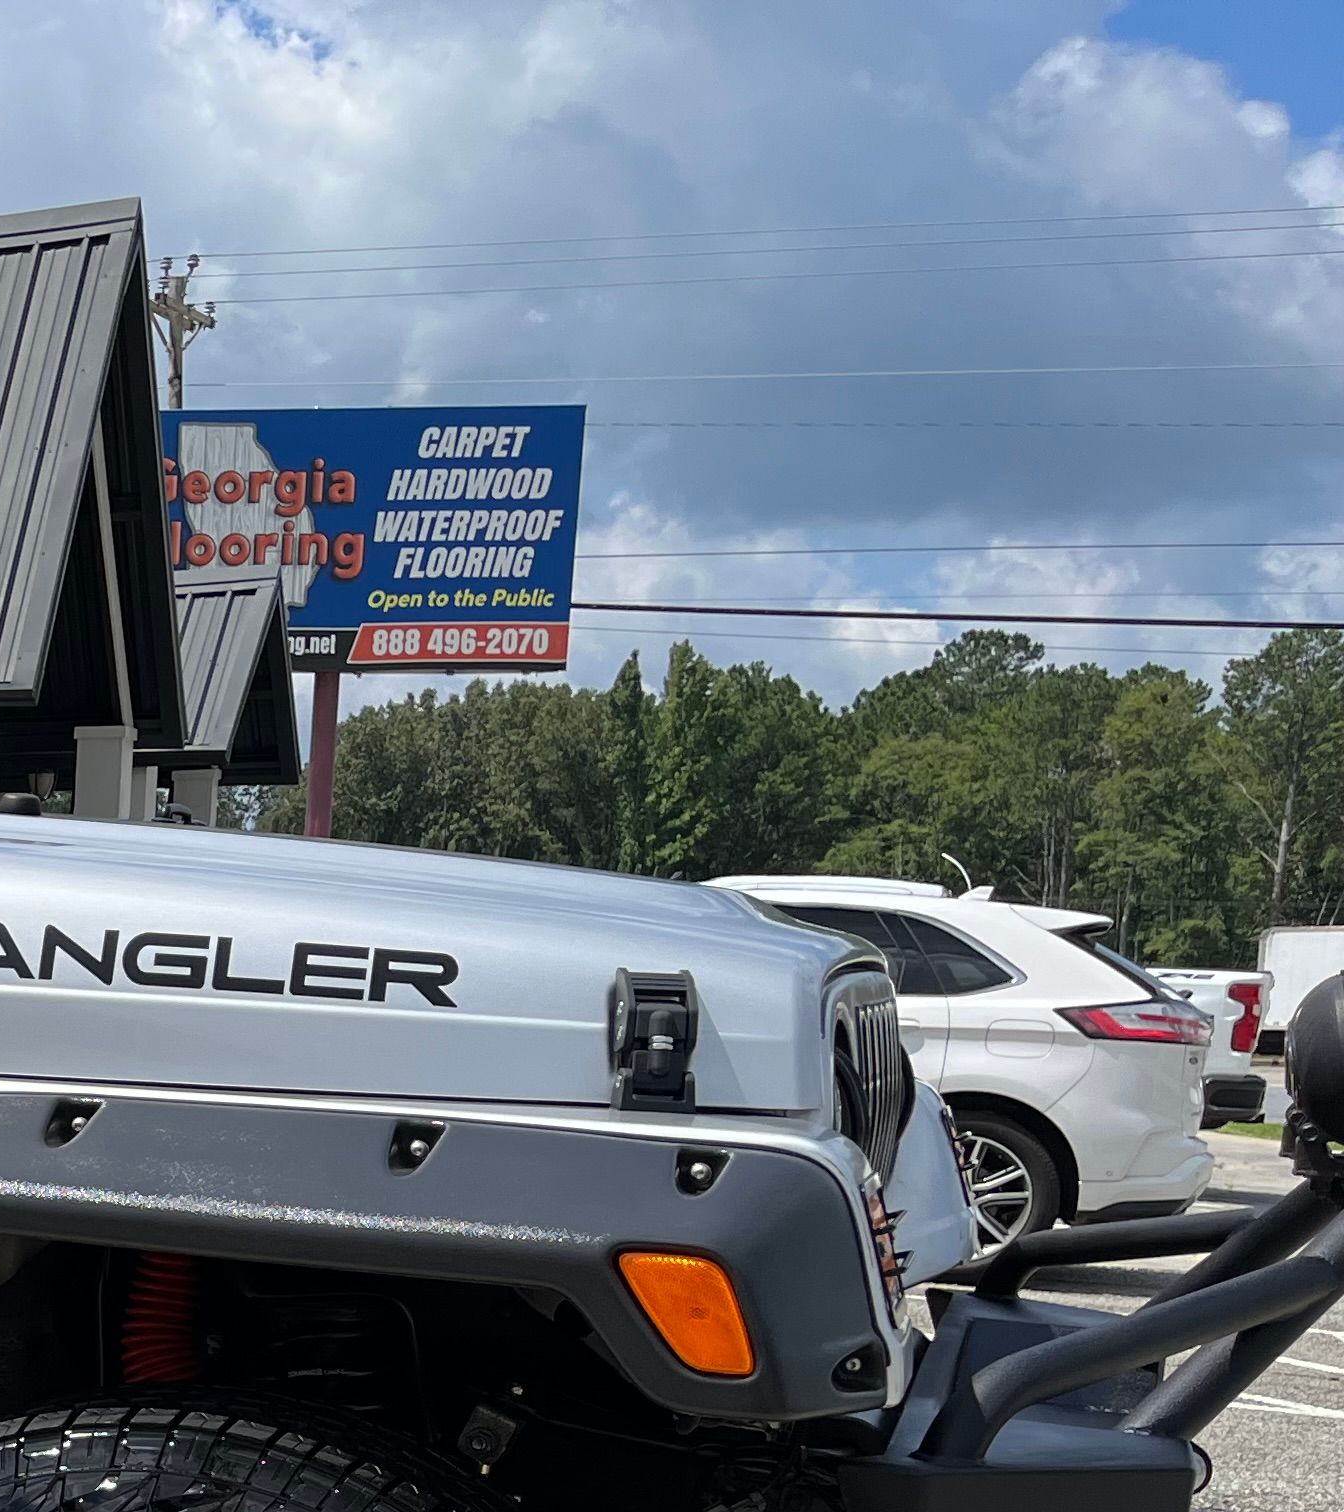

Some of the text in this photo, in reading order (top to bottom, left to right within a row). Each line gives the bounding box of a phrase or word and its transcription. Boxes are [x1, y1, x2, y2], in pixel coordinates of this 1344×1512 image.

[417, 426, 531, 459] CARPET
[386, 467, 553, 501] HARDWOOD
[373, 509, 564, 543] WATERPROOF
[170, 521, 365, 579] looring
[393, 546, 535, 579] FLOORING
[367, 588, 555, 612] Open to the Public
[287, 634, 336, 656] ng.net
[372, 627, 549, 656] 888 496-2070
